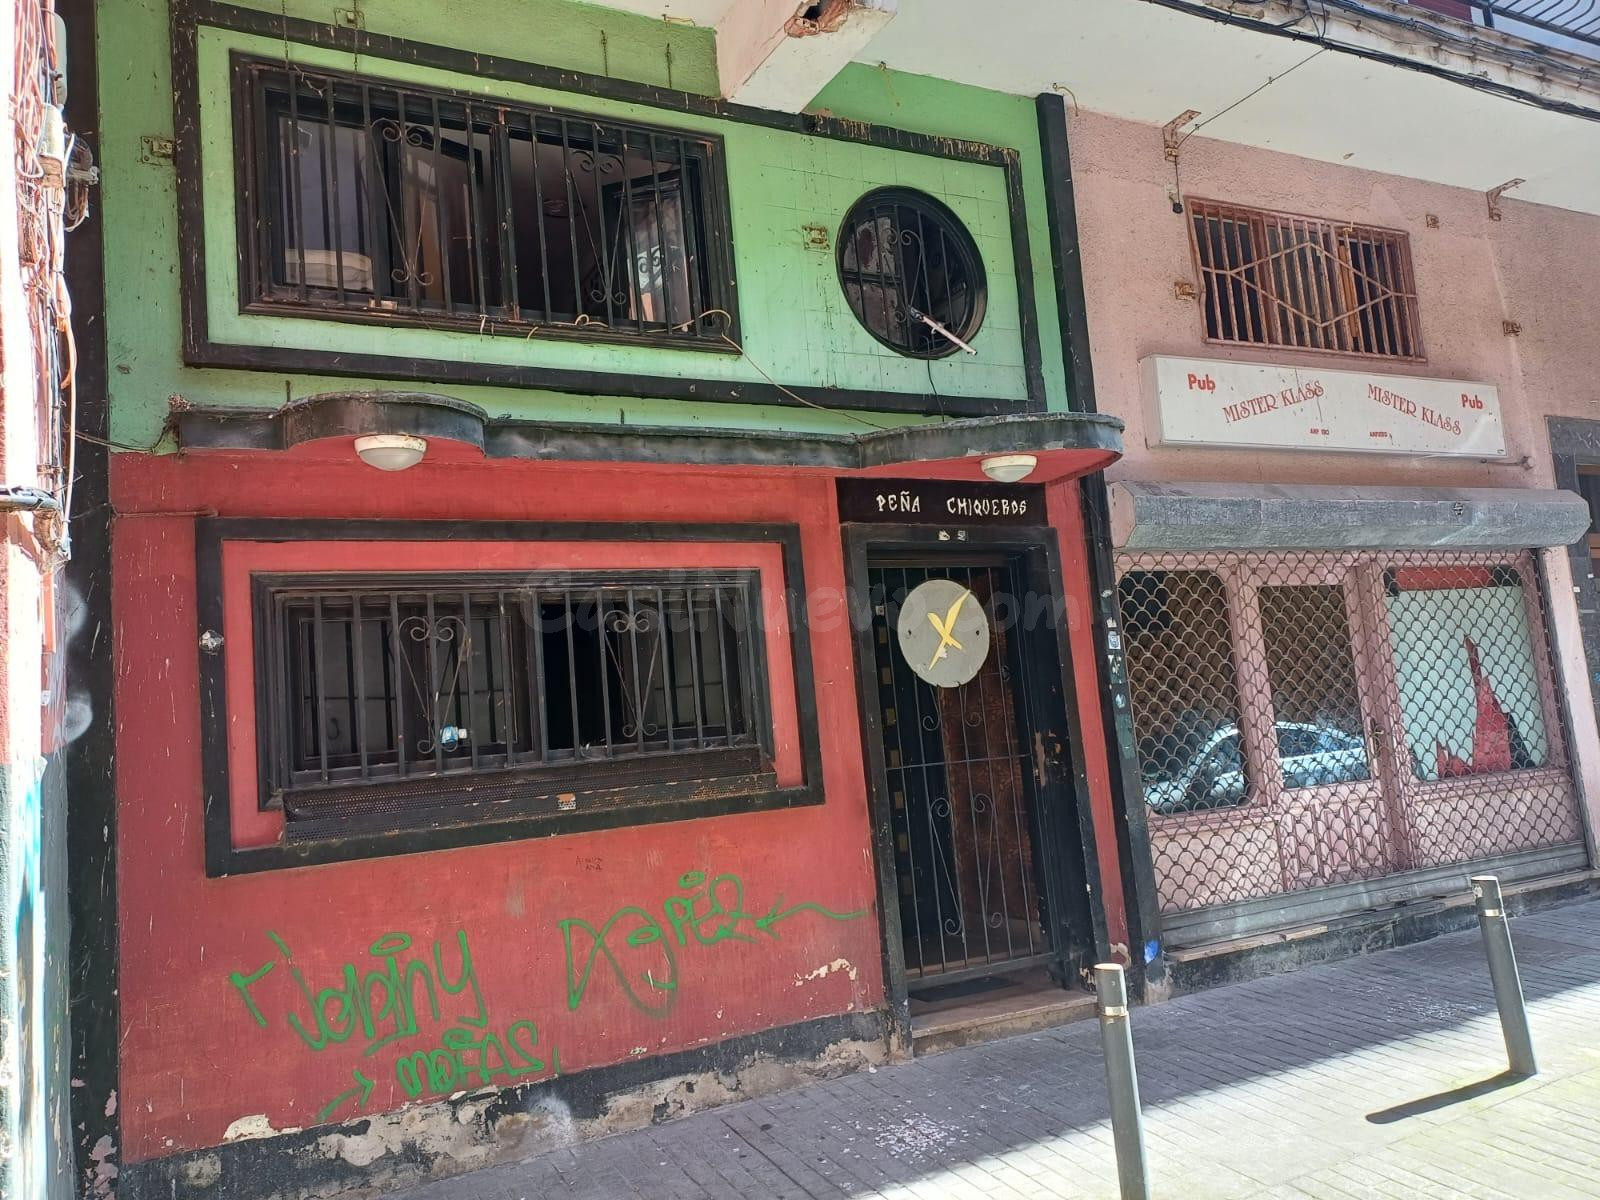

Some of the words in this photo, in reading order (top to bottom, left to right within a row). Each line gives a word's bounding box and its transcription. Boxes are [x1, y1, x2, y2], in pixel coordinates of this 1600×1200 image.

[1187, 373, 1216, 391] Pub
[1222, 394, 1279, 423] MISTER
[1281, 380, 1324, 407] KLASS
[1368, 384, 1417, 418] MISTER
[1421, 406, 1462, 436] KLASS
[1461, 393, 1484, 410] Pub
[876, 491, 921, 513] PEÑA
[947, 497, 1027, 517] CHIQUEROS
